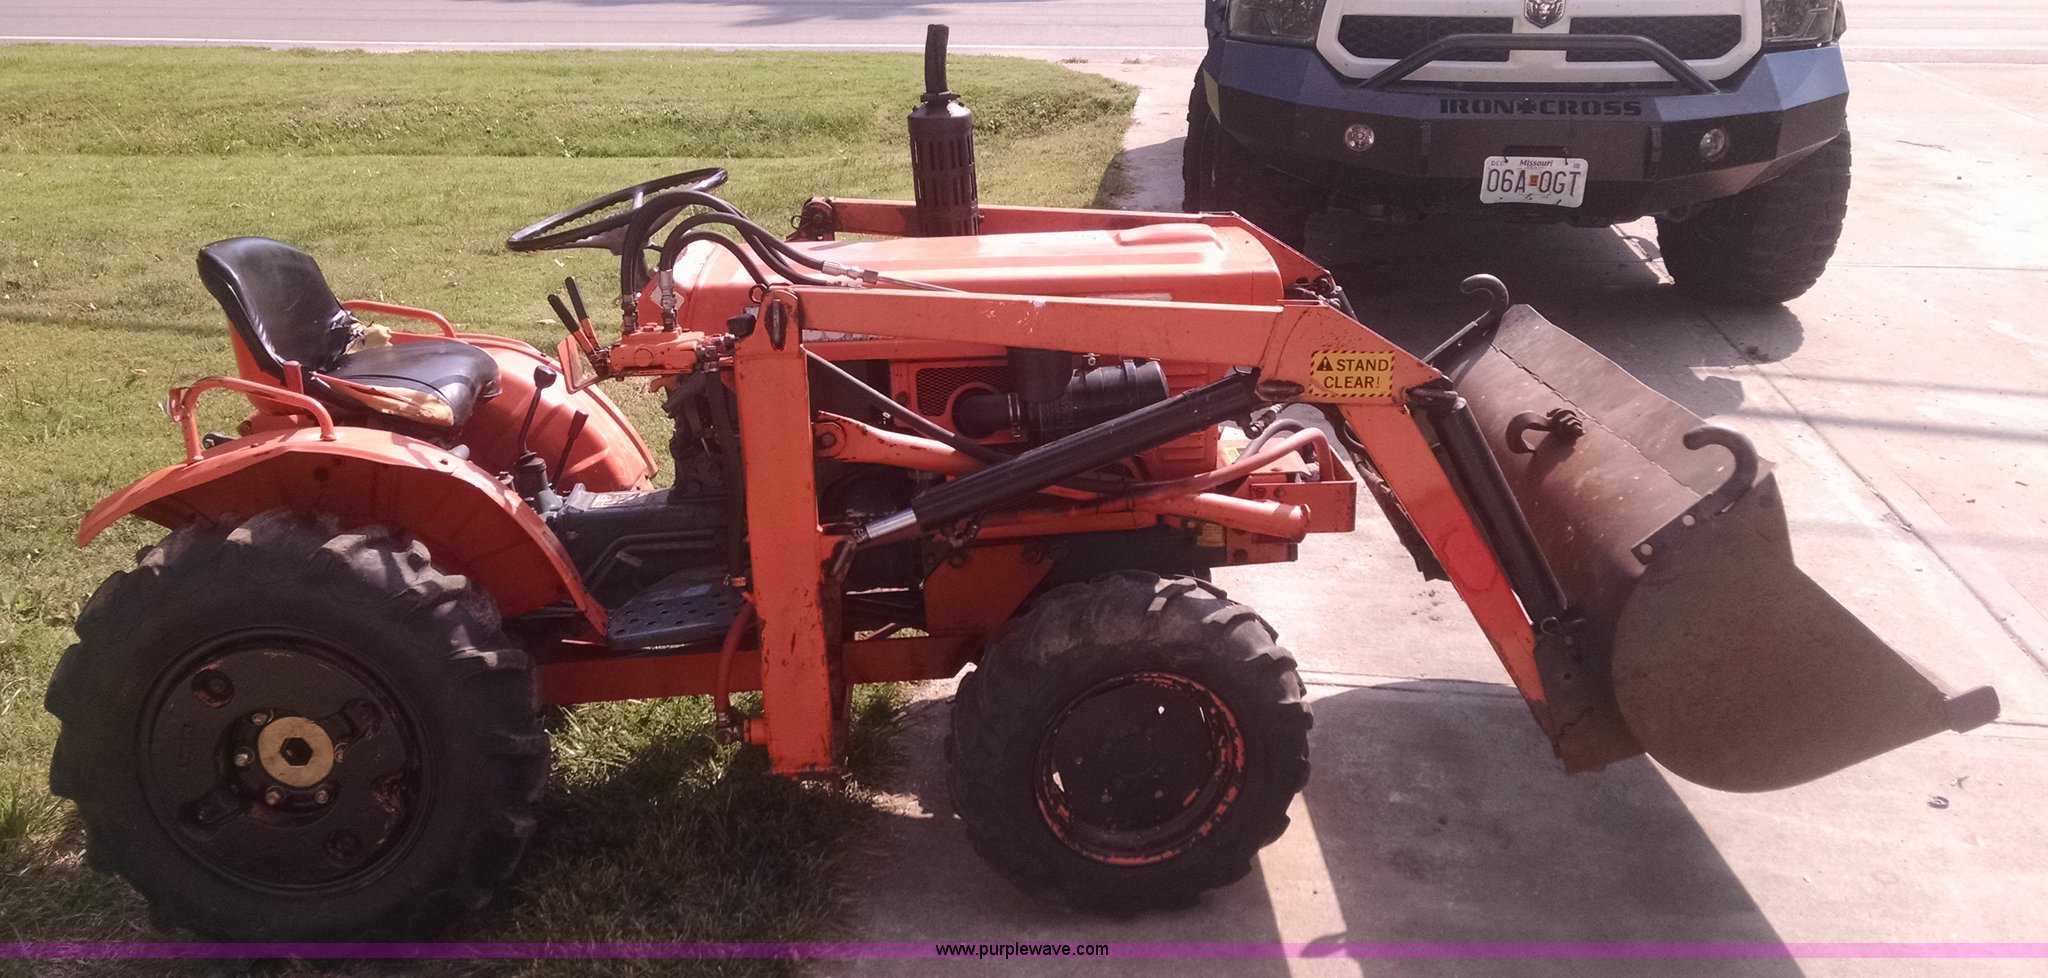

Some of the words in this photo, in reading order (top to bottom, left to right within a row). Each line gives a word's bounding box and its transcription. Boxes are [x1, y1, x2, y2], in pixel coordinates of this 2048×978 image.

[1440, 98, 1515, 115] IRON
[1539, 99, 1642, 116] CROSS
[1519, 159, 1554, 168] Missouri
[1487, 168, 1526, 193] 06A
[1336, 358, 1389, 372] STAND
[1323, 375, 1380, 389] CLEAR!
